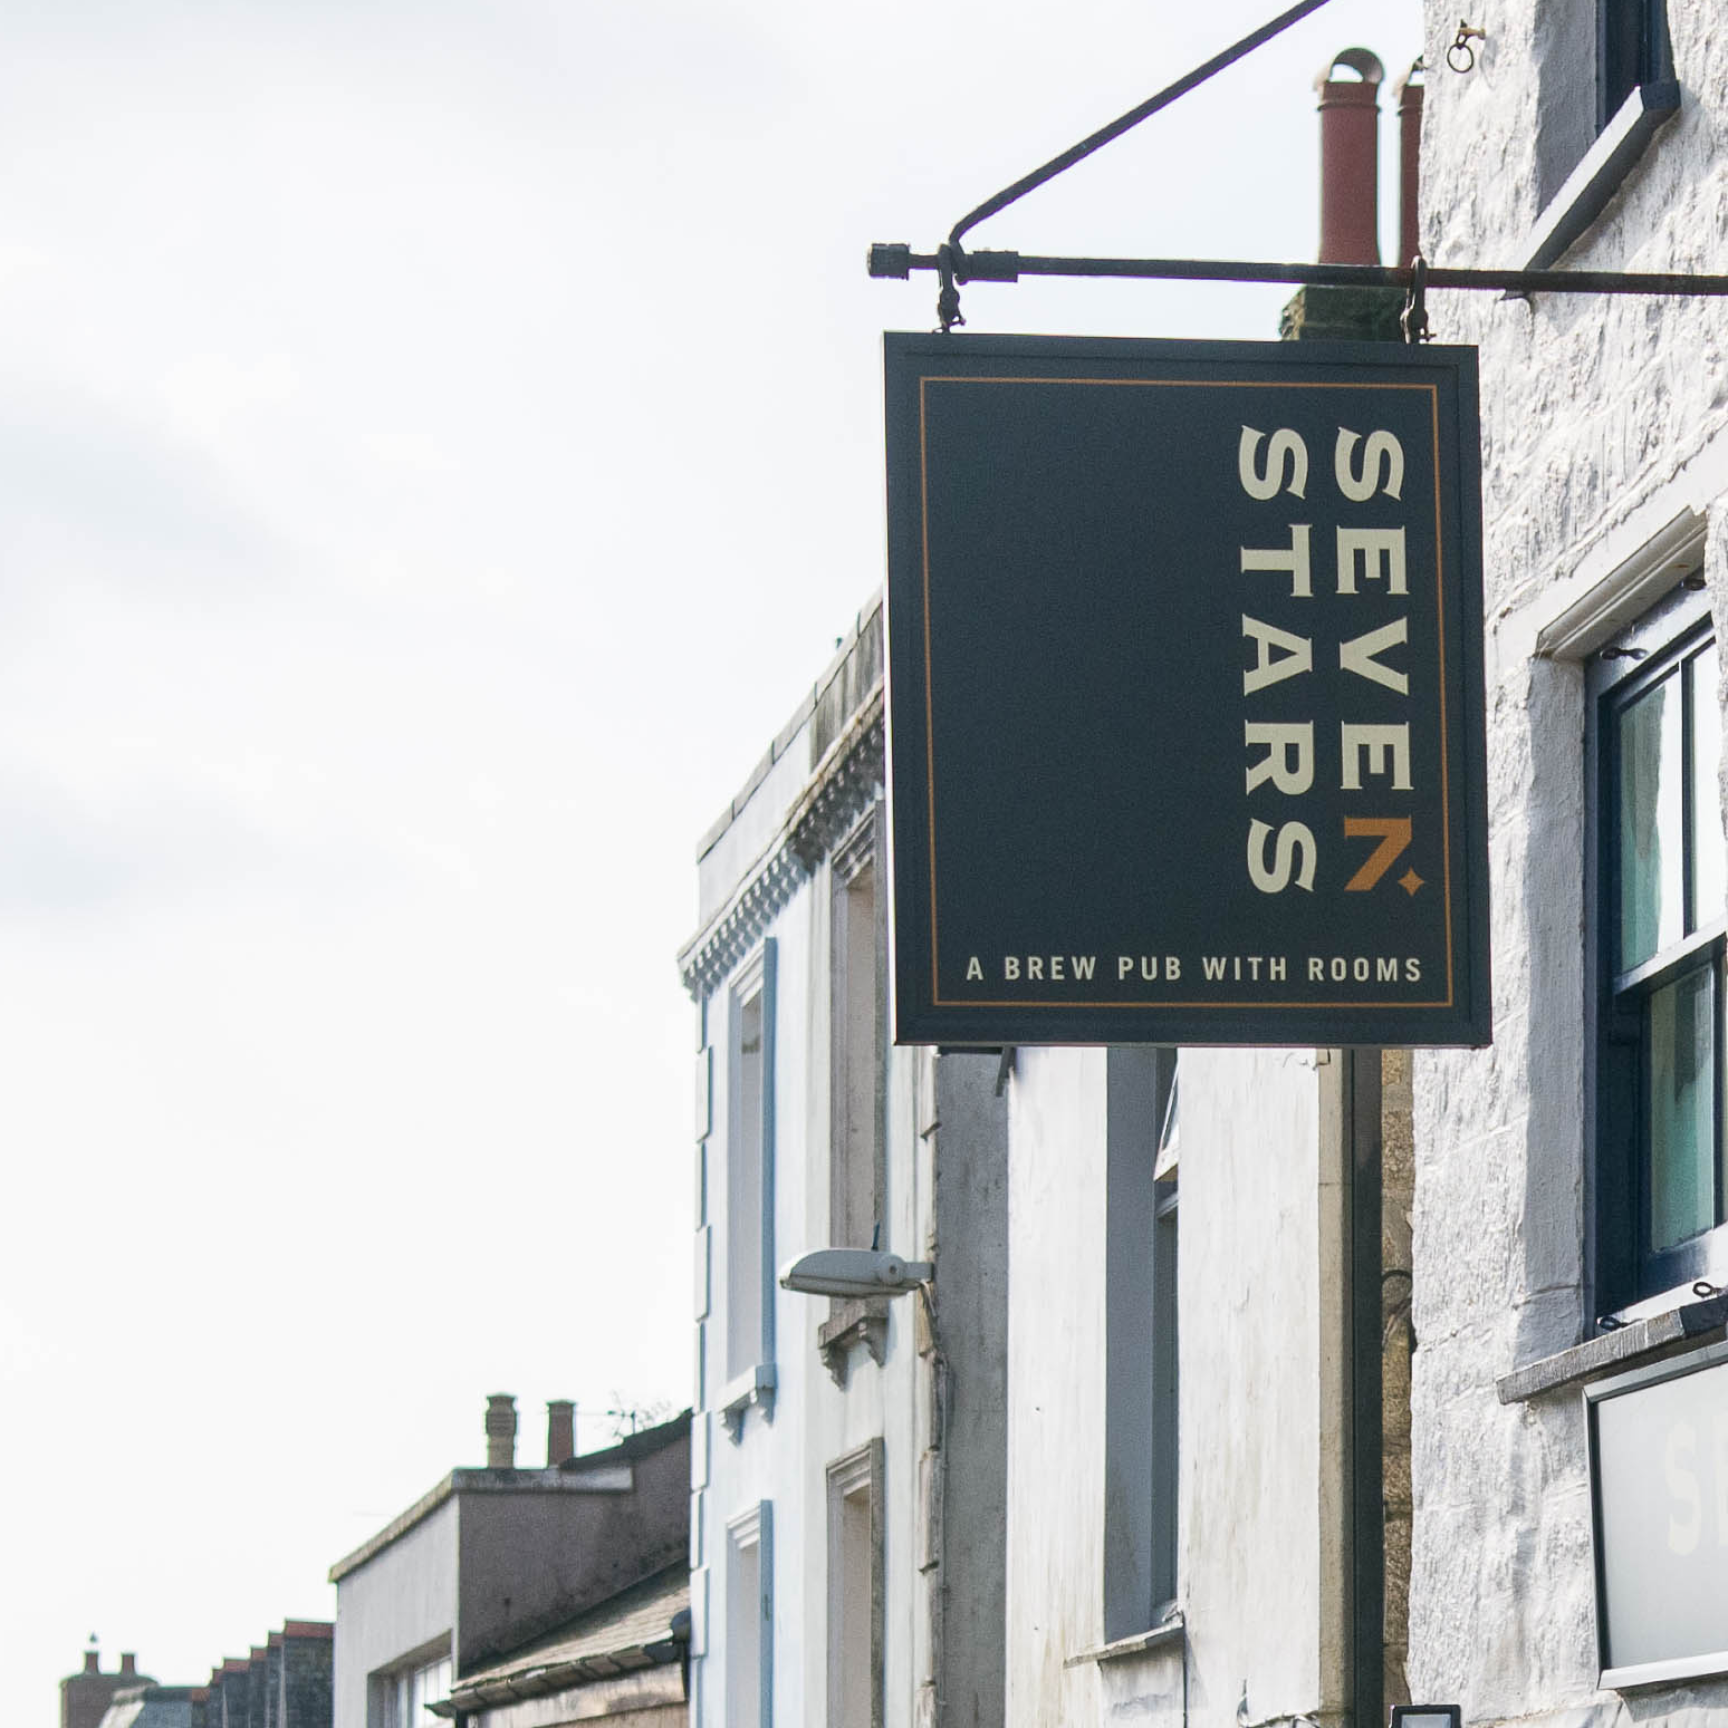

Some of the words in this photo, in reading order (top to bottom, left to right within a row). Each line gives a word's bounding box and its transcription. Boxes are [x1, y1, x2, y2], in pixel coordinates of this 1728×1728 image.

[1238, 425, 1318, 893] STARS
[966, 956, 984, 982] A
[1003, 956, 1097, 982] BREW
[1117, 956, 1183, 982] PUB
[1202, 956, 1287, 982] WITH
[1307, 956, 1423, 982] ROOMS
